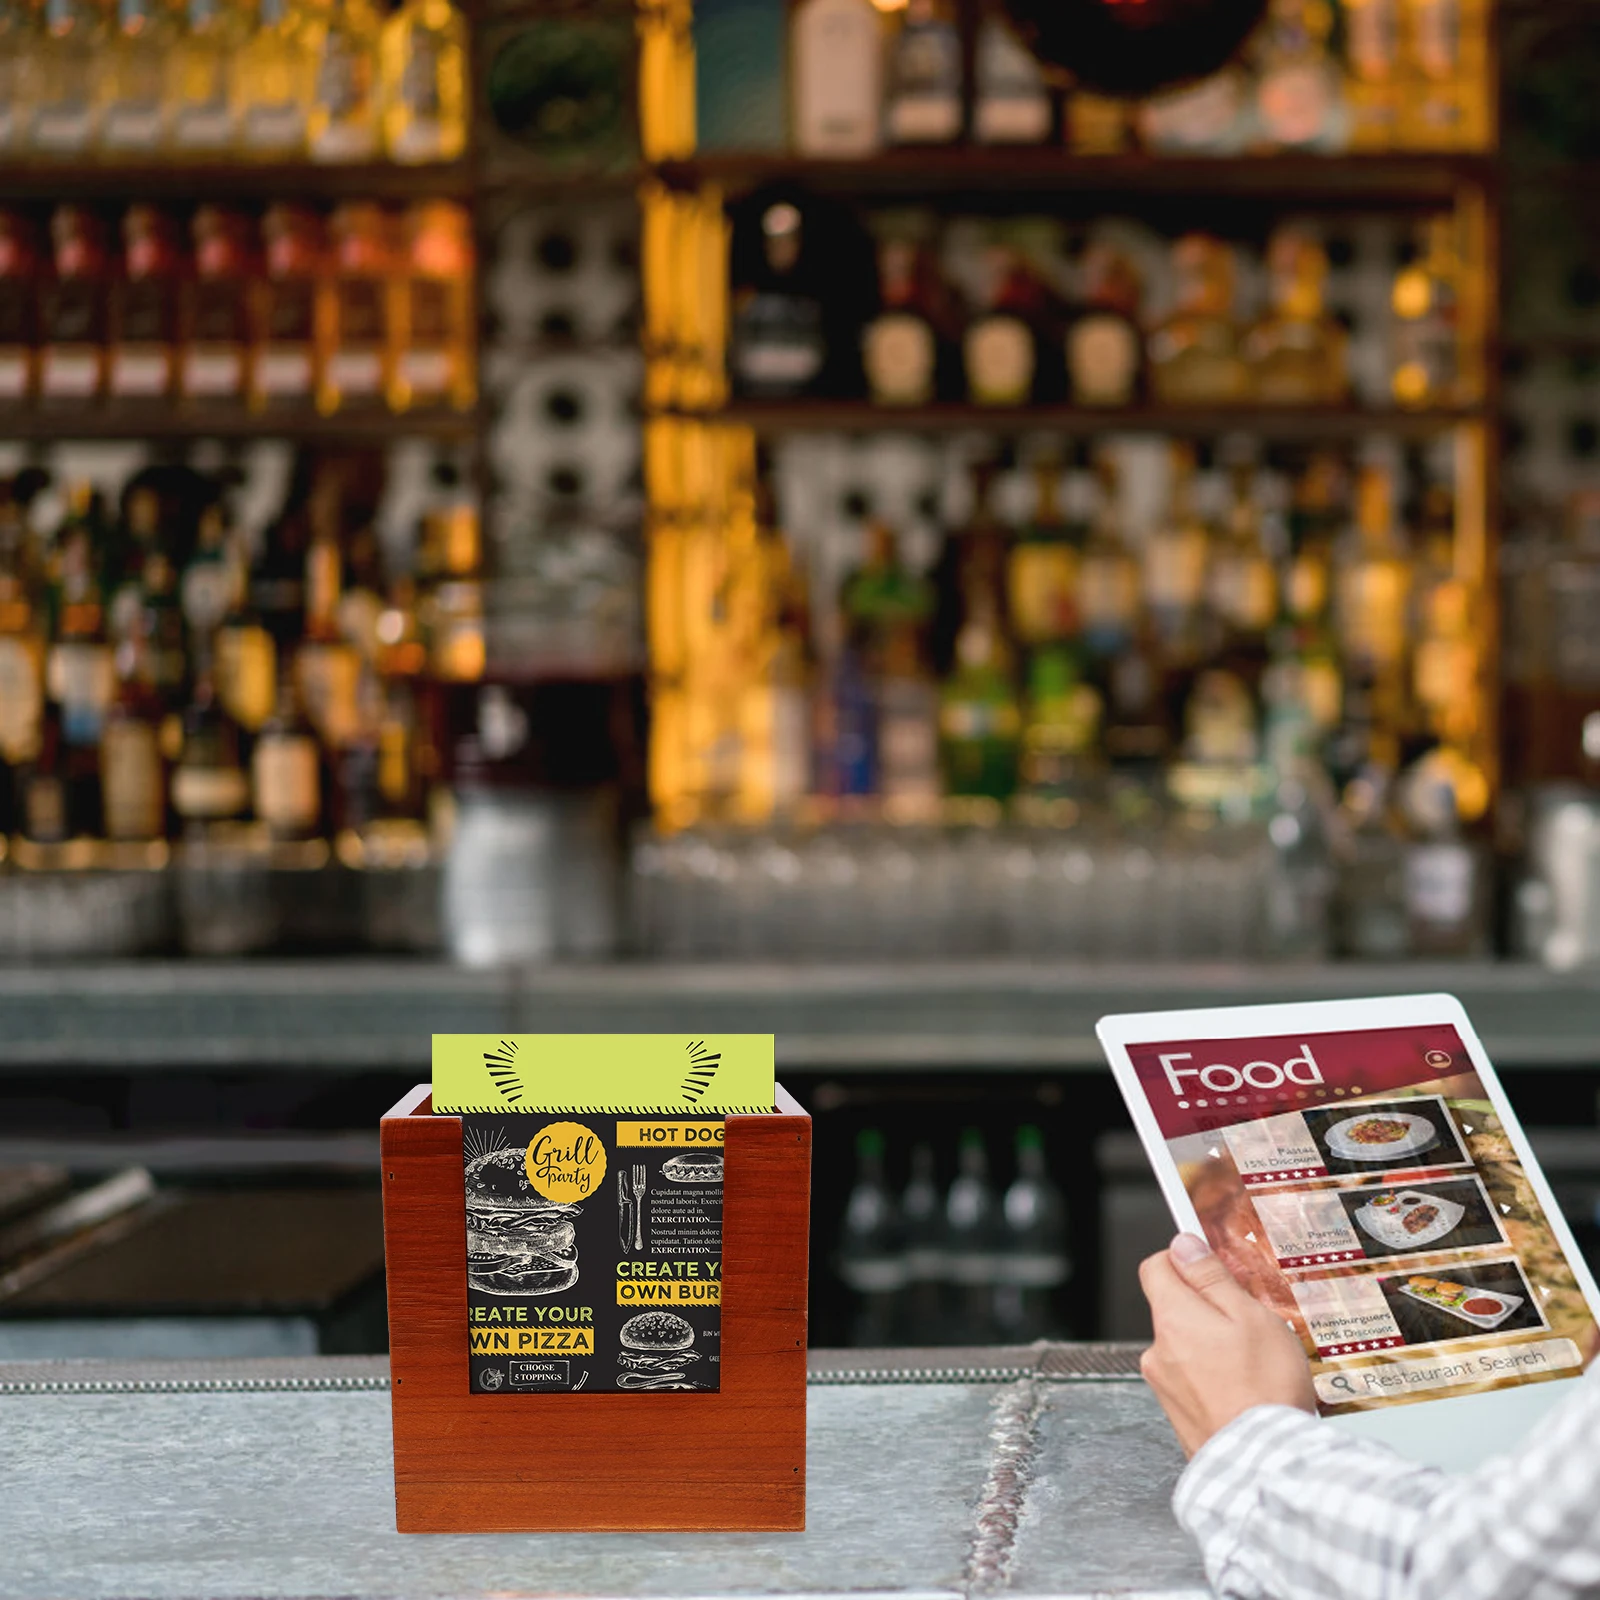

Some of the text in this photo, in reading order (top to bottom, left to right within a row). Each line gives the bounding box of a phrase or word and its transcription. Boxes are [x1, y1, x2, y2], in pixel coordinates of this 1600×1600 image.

[1158, 1044, 1325, 1096] Food
[639, 1127, 725, 1142] HOT DOG
[532, 1135, 599, 1178] Grill
[547, 1167, 591, 1194] party
[650, 1188, 682, 1197] Cupidatat
[650, 1237, 681, 1246] cupidatat.
[682, 1237, 703, 1245] Tation
[616, 1261, 722, 1277] CREATE Y
[620, 1284, 672, 1300] OWN
[534, 1306, 593, 1322] YOUR
[518, 1332, 589, 1349] PIZZA
[519, 1363, 555, 1371] CHOOSE
[1363, 1350, 1546, 1389] Restaurant Search
[514, 1373, 562, 1381] 5 TOPPINGS
